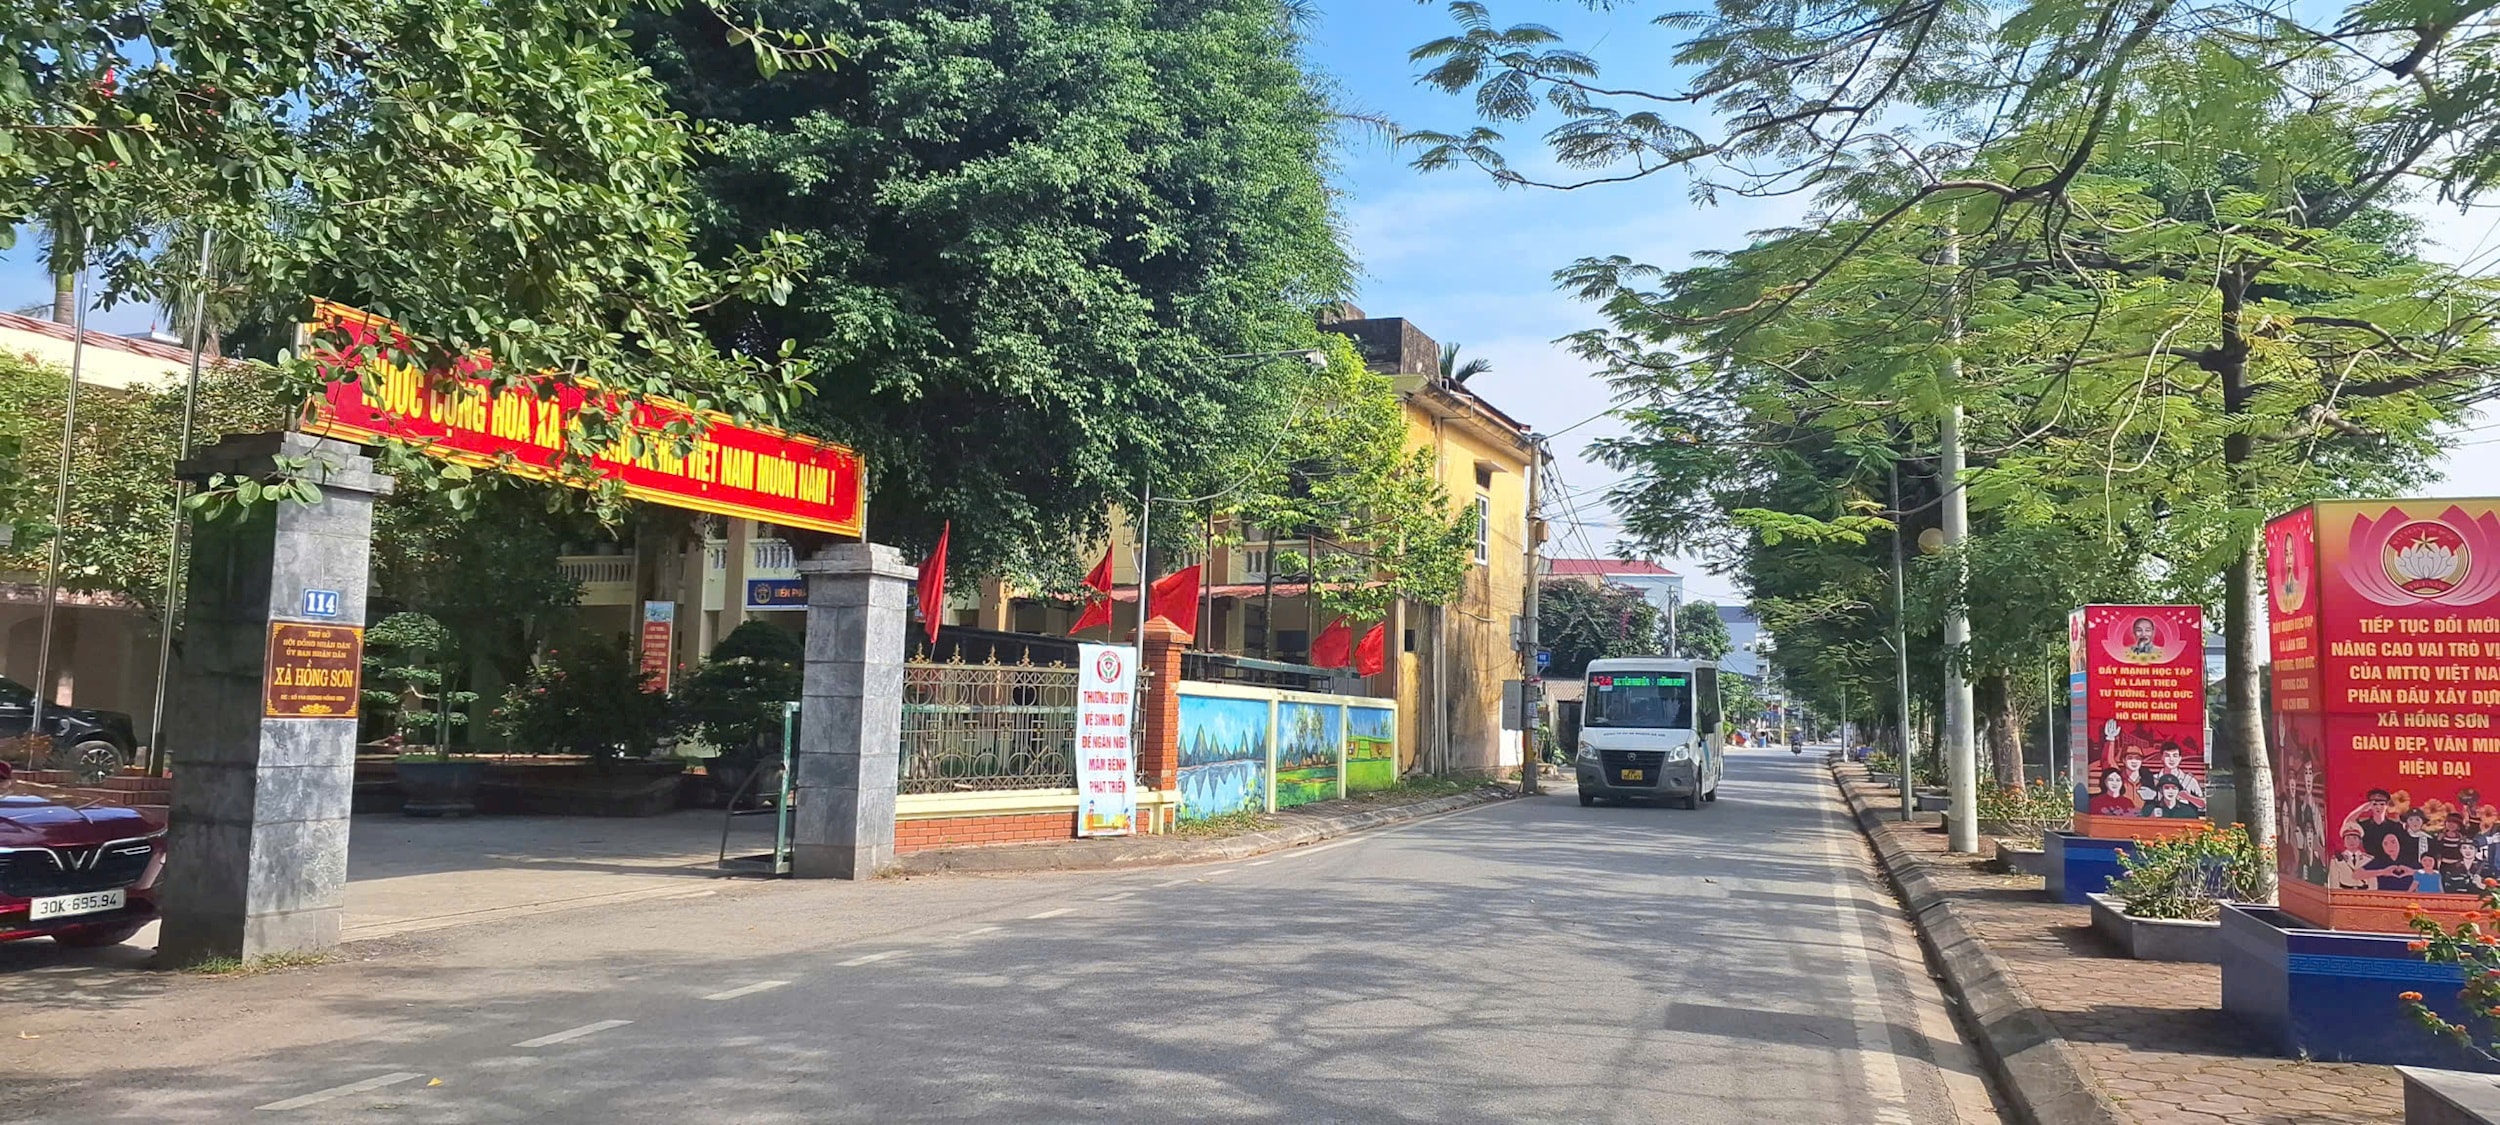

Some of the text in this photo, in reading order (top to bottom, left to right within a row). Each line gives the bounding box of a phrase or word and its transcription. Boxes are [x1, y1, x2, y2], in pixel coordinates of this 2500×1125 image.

[688, 433, 719, 491] VIỆT
[721, 446, 755, 490] NAM
[757, 451, 796, 498] MUÔN
[798, 458, 828, 505] NĂM
[307, 592, 335, 613] 114
[2359, 615, 2394, 633] TIẾP
[2399, 619, 2429, 636] TỤC
[2434, 614, 2462, 633] ĐỔI
[2331, 640, 2377, 657] NÂNG
[2381, 642, 2413, 657] CAO
[2418, 643, 2444, 657] VAI
[2448, 640, 2480, 657] TRÒ
[274, 659, 354, 687] XÃ HỒNG SƠN
[2120, 667, 2149, 677] MẠNH
[2152, 668, 2172, 677] HỌC
[2350, 661, 2500, 683] CỦA MTTQ VIỆT NA
[2153, 679, 2178, 687] THEO
[2099, 689, 2111, 697] TƯ
[2151, 690, 2171, 700] ĐẠO
[2348, 684, 2392, 703] PHẤN
[2397, 685, 2430, 703] ĐẤU
[2435, 687, 2467, 704] XÂY
[2115, 701, 2148, 709] PHONG
[1095, 713, 1110, 726] SINH
[2132, 711, 2148, 720] CHÍ
[2151, 713, 2178, 721] MINH
[2378, 710, 2399, 727] XÃ
[2454, 712, 2490, 729] SƠN
[2352, 733, 2390, 750] GIÀU
[2395, 736, 2429, 754] ĐẸP,
[2434, 735, 2468, 752] VĂN
[2399, 758, 2471, 779] HIỆN ĐẠI
[40, 893, 117, 914] 30K-695.94
